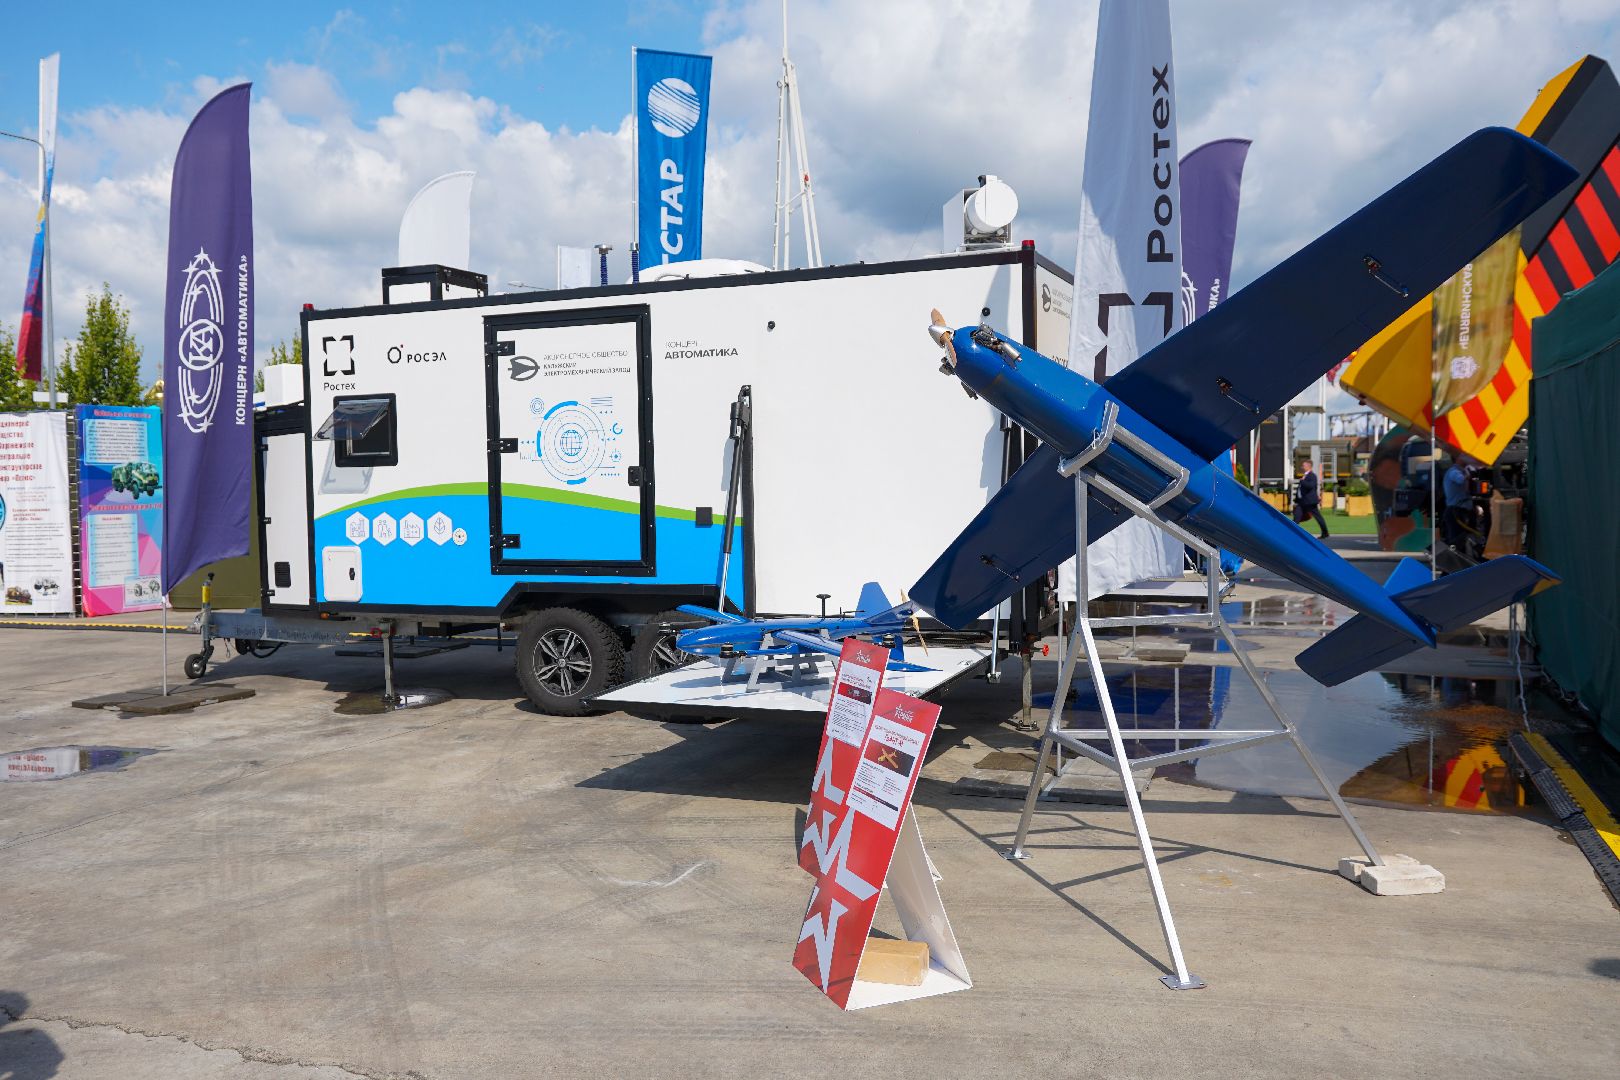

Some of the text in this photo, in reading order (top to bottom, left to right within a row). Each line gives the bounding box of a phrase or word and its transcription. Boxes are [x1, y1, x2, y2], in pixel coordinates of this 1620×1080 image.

[660, 158, 684, 265] СТАР
[1147, 62, 1174, 262] Ростех
[235, 254, 248, 425] КОНЦЕРН «АВТОМАТИКА»
[323, 382, 356, 391] Ростех
[664, 348, 739, 360] АВТОМАТИКА
